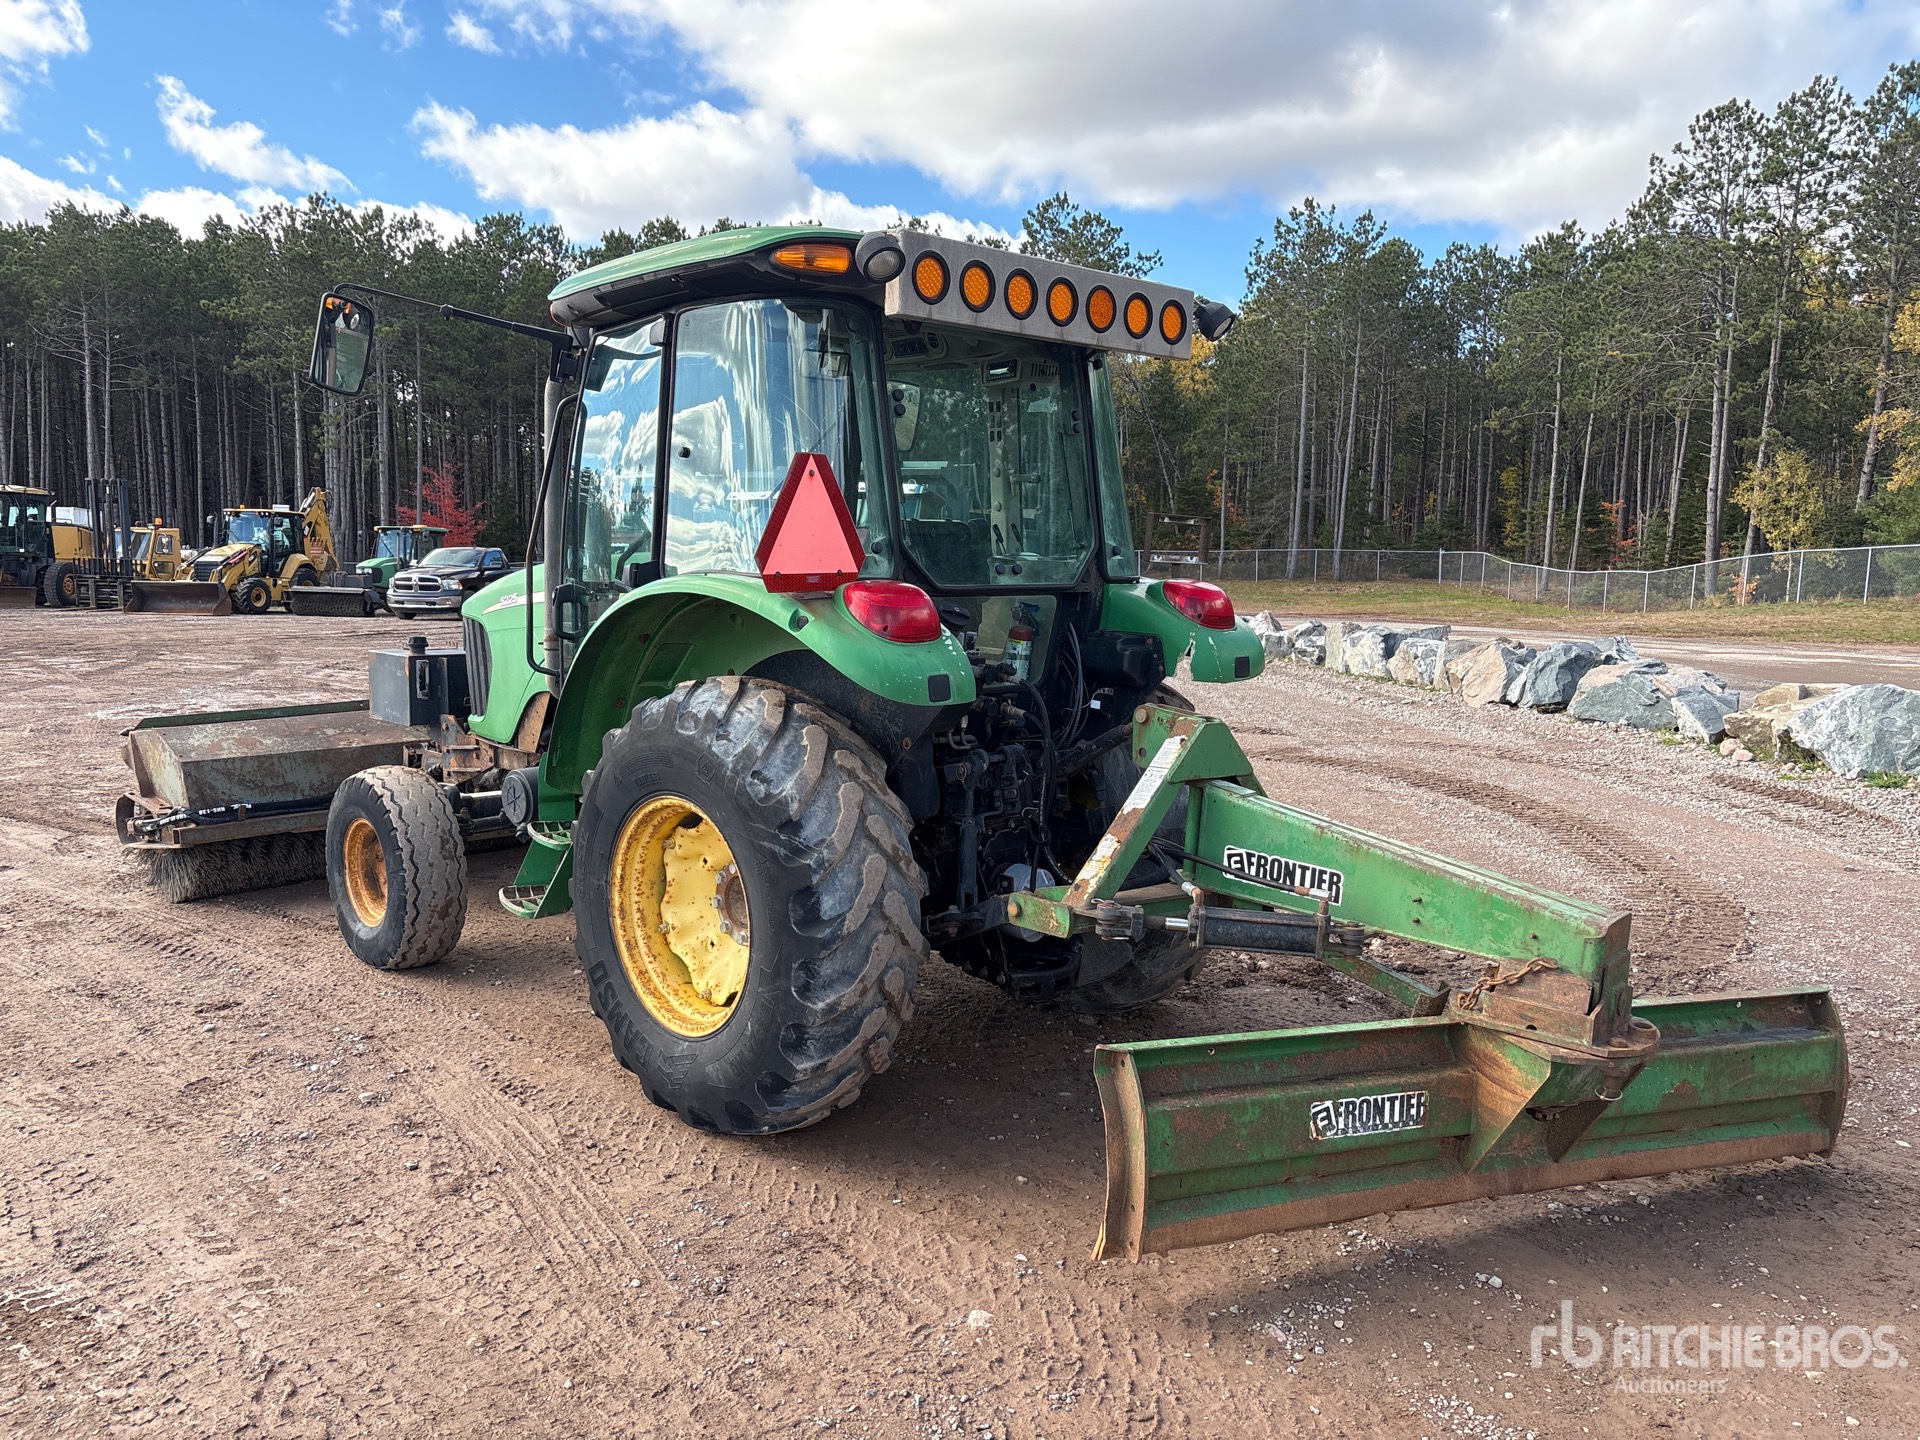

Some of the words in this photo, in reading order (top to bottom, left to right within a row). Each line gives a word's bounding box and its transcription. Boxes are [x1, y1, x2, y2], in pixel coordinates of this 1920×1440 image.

[1244, 850, 1341, 905] FRONTIER
[588, 958, 654, 1072] CAMSO
[1335, 1092, 1426, 1131] FRONTIER
